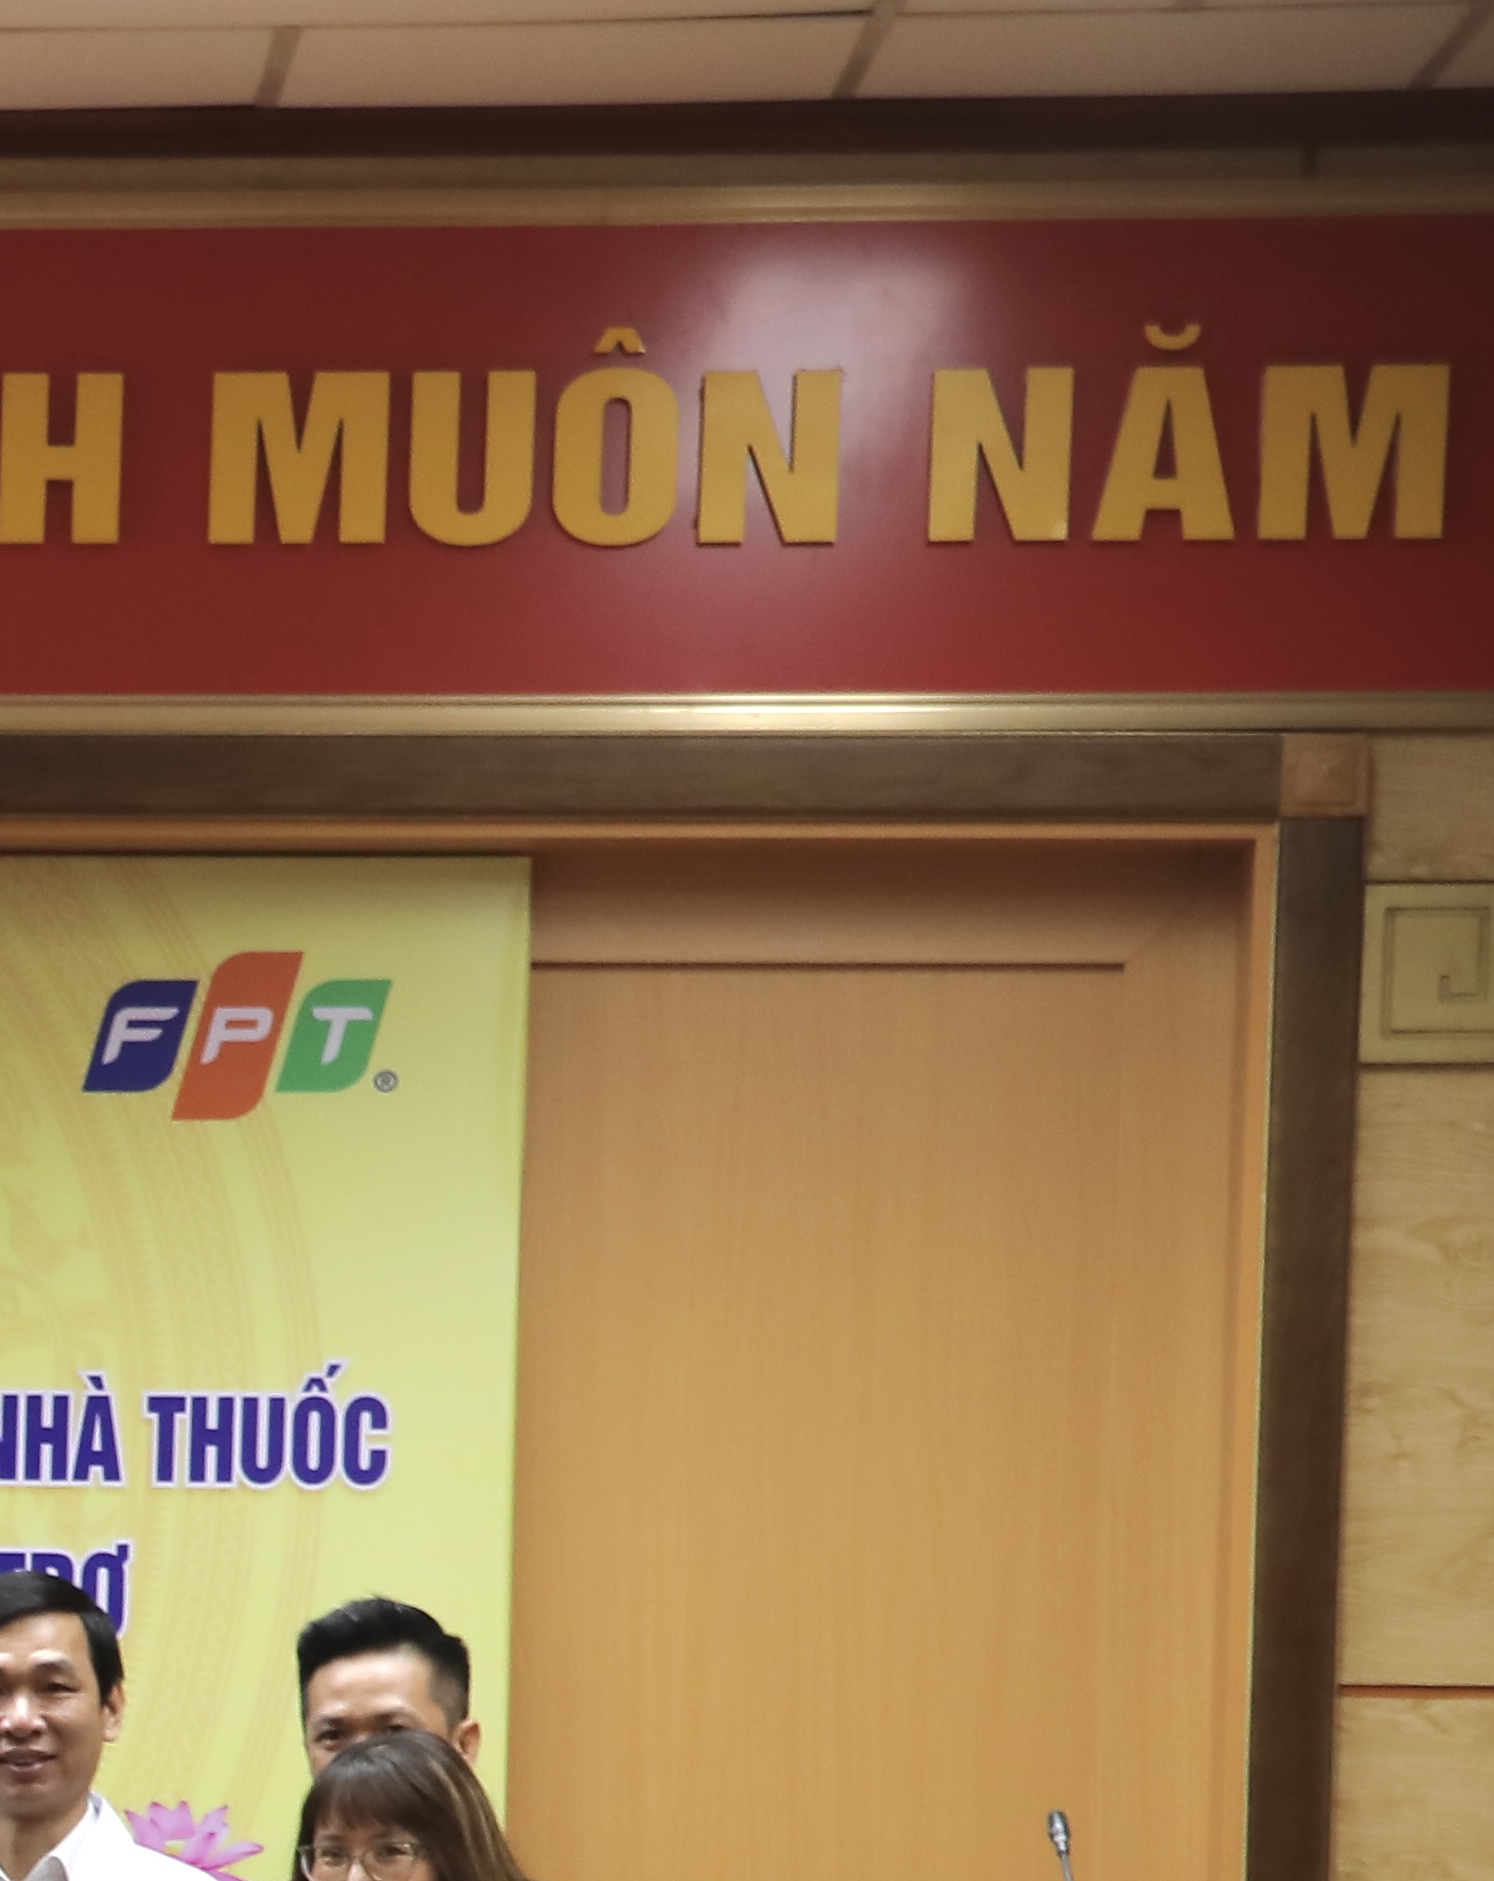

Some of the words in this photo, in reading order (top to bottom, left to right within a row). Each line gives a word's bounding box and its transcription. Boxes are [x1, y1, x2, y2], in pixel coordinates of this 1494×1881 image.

[207, 326, 841, 548] MUÔN
[928, 332, 1428, 541] NĂM
[148, 1365, 387, 1485] THUỐC
